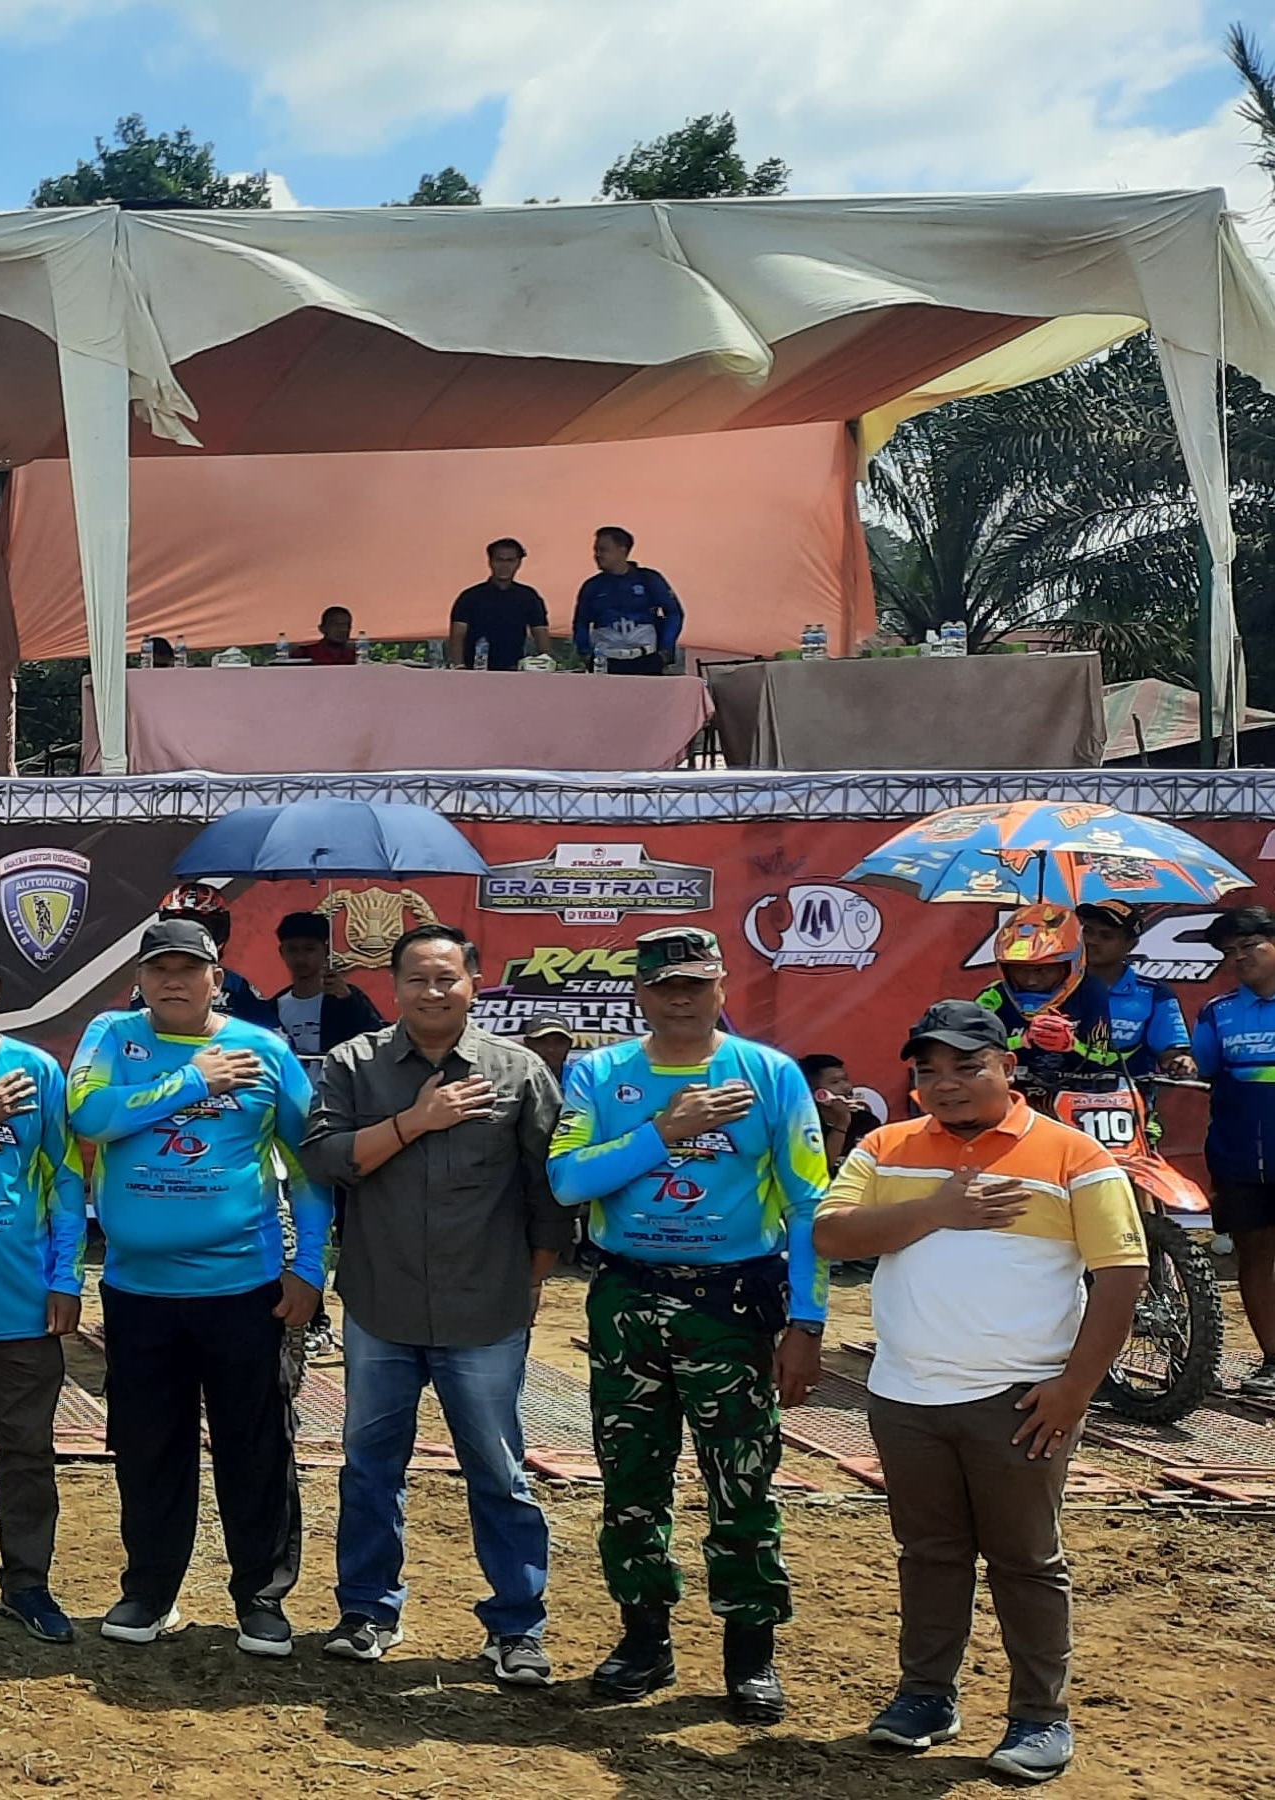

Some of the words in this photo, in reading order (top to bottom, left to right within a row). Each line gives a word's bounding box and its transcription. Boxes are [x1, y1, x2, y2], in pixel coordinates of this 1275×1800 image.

[570, 859, 624, 867] SWALLOW
[15, 878, 77, 891] AUTOMOTIF
[487, 879, 703, 897] GRASSTRACK
[8, 909, 30, 946] RIAU
[576, 910, 616, 921] YAMAHA
[518, 947, 638, 983] RAC
[1133, 960, 1220, 980] NDIRI
[1079, 1110, 1135, 1141] 110
[153, 1127, 211, 1167] 79
[648, 1171, 708, 1214] 79
